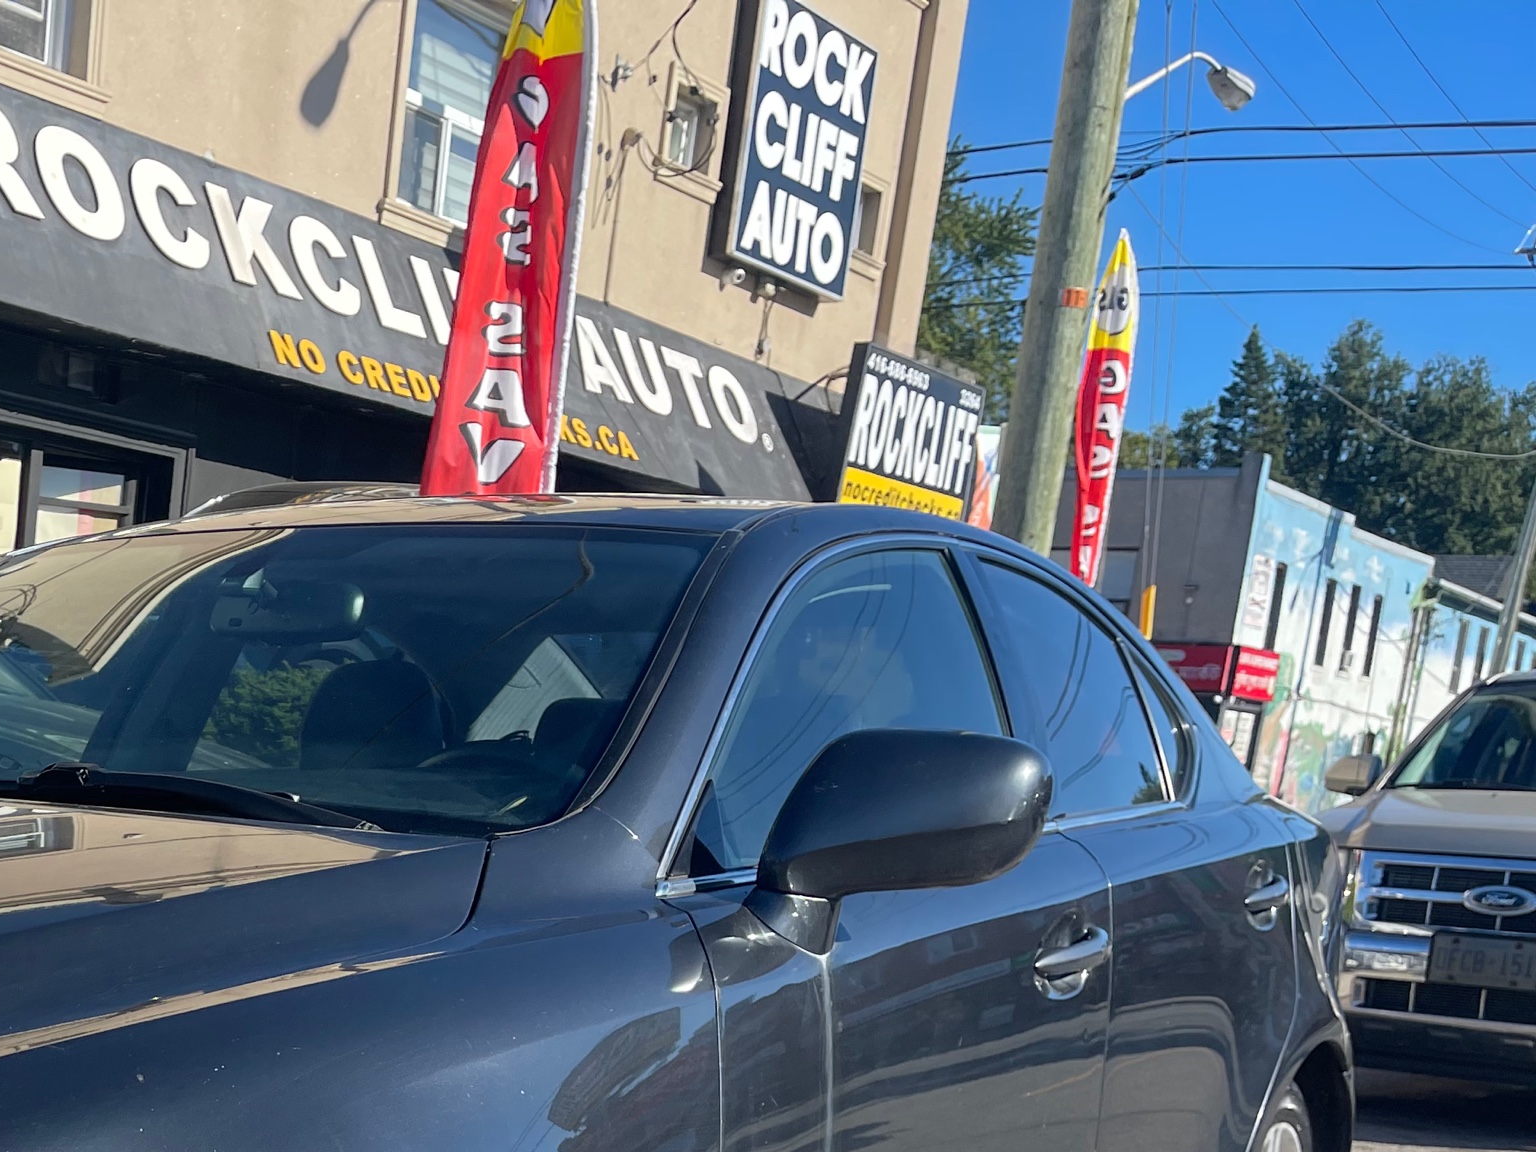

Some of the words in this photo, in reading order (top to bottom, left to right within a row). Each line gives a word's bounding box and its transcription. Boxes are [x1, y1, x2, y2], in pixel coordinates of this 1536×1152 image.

[760, 0, 875, 124] ROCK
[755, 91, 860, 202] CLIFF
[740, 180, 845, 285] AUTO
[268, 329, 326, 375] NO
[848, 373, 978, 495] ROCKCLIFF
